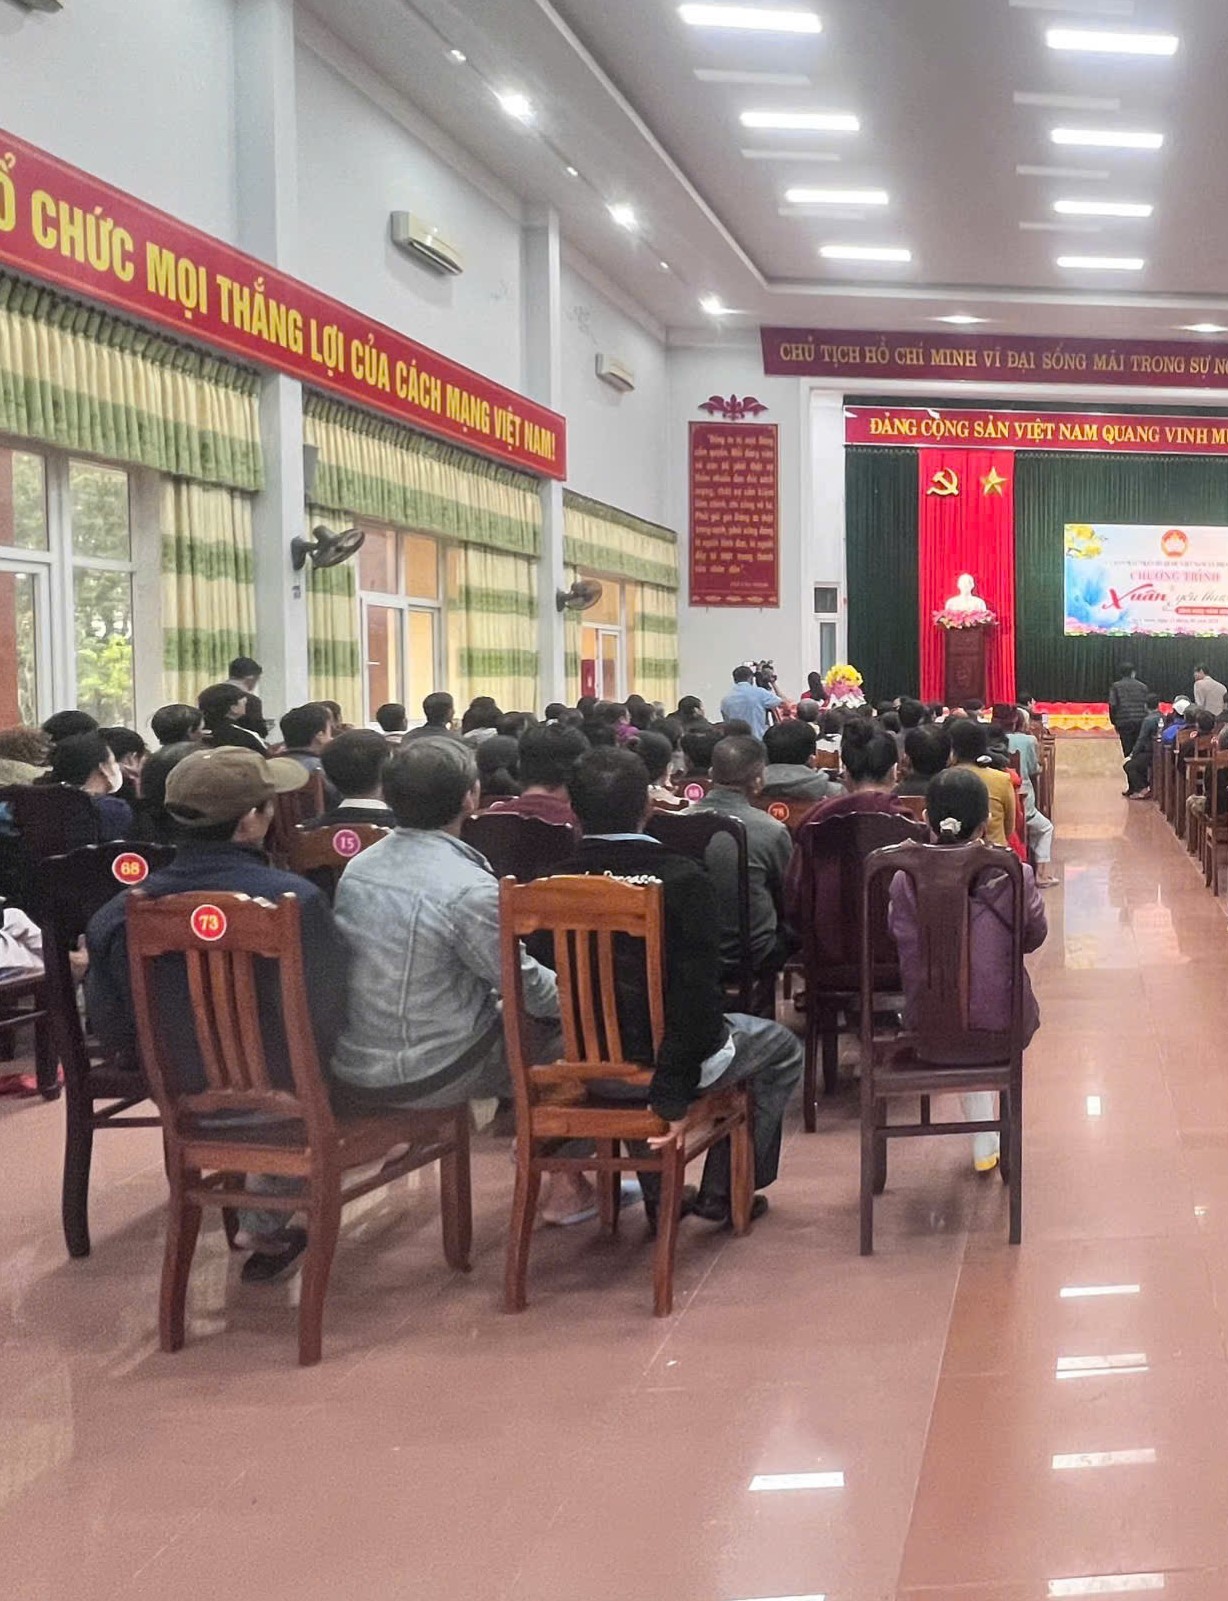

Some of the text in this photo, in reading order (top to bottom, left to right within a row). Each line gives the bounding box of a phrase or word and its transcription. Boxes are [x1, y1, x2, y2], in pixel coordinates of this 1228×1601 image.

[31, 189, 135, 282] CHỨC
[146, 241, 208, 319] MỌI
[216, 273, 303, 355] THẮNG
[310, 318, 344, 377] LỢI
[351, 332, 391, 392] CỦA
[396, 359, 441, 414] CÁCH
[446, 383, 490, 434] MẠNG
[494, 405, 522, 451] VIỆT
[524, 420, 555, 461] NAM!
[779, 336, 815, 361] CHỦ
[820, 344, 860, 368] TỊCH
[865, 336, 890, 364] HỒ
[895, 341, 925, 365] CHÍ
[931, 349, 977, 367] MINH
[983, 346, 1001, 367] VĨ
[1007, 350, 1036, 374] ĐẠI
[1042, 342, 1087, 370] SỐNG
[1130, 354, 1185, 373] TRONG
[1189, 354, 1210, 379] SỰ
[869, 412, 917, 435] ĐẢNG
[920, 415, 969, 440] CỘNG
[973, 414, 1010, 439] SẢN
[1014, 418, 1055, 443] VIỆT
[1059, 423, 1098, 442] NAM
[1102, 424, 1160, 444] QUANG
[1165, 426, 1209, 444] VINH
[1102, 583, 1167, 609] Xuân
[340, 836, 354, 849] 15
[198, 914, 219, 931] 73
